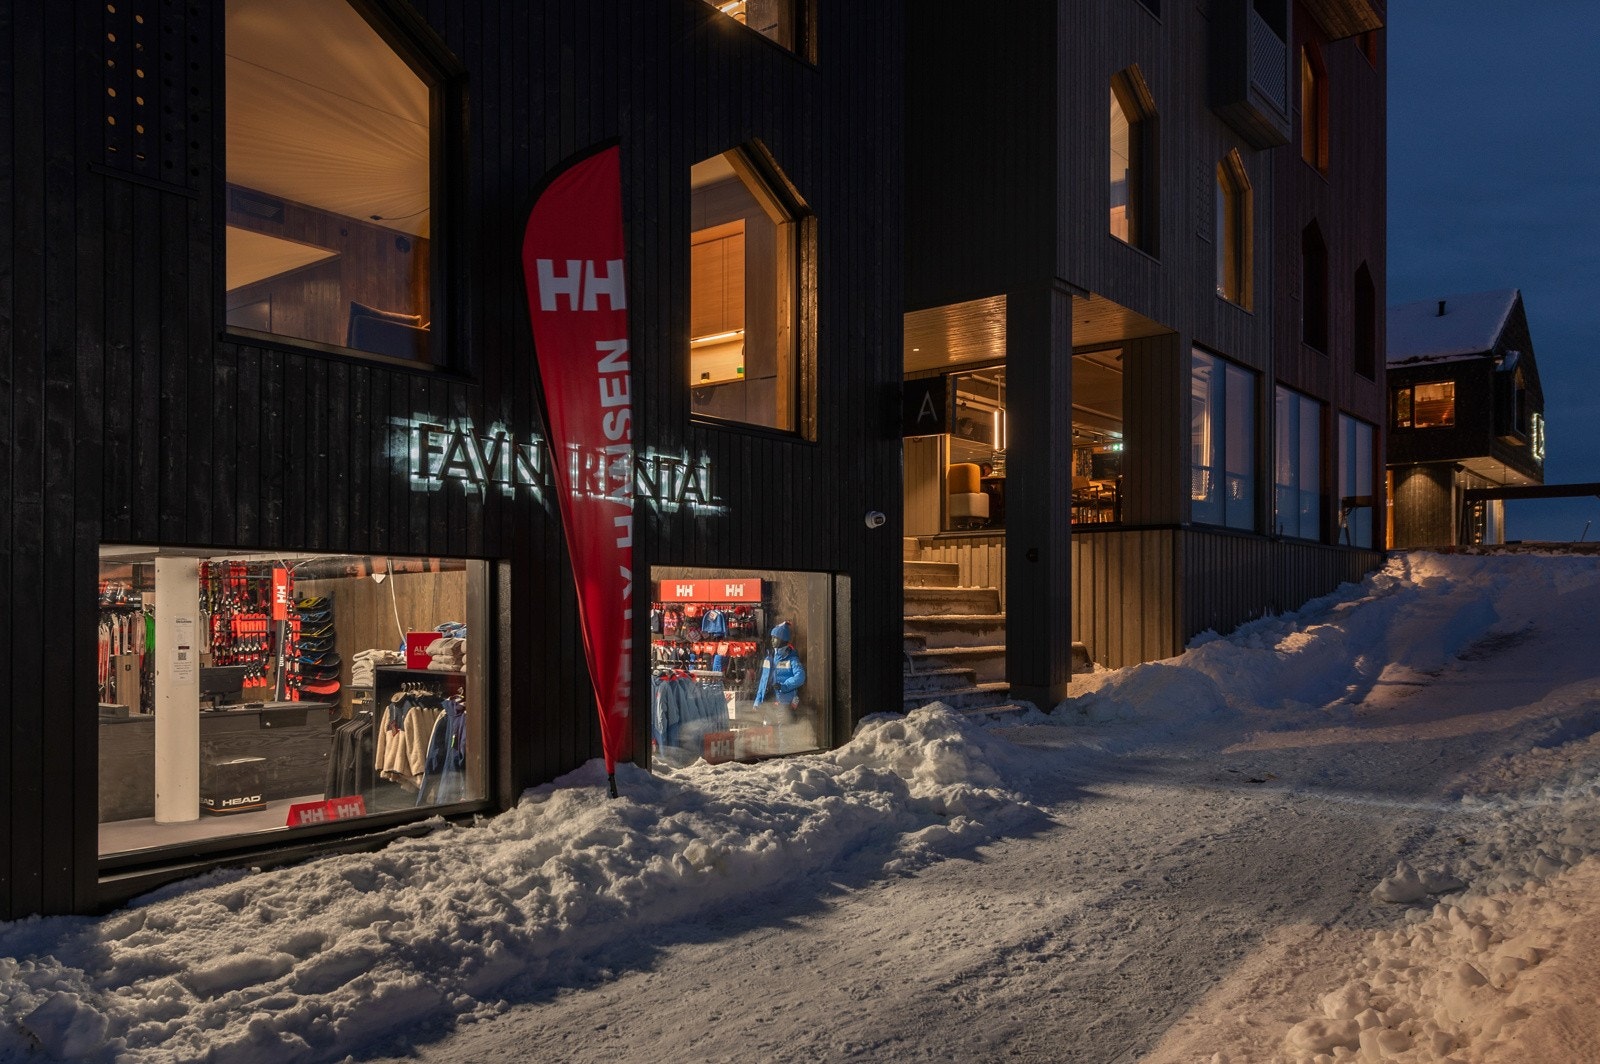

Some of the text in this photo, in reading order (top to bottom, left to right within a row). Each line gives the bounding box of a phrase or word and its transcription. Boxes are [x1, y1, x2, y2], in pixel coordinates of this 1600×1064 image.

[536, 258, 626, 311] HH
[917, 390, 938, 424] A
[418, 421, 548, 492] FAVN
[277, 585, 286, 603] HH
[676, 584, 693, 597] HH
[725, 584, 744, 597] HH
[222, 795, 261, 807] HEAD
[300, 807, 325, 824] HH
[338, 802, 361, 818] HH
